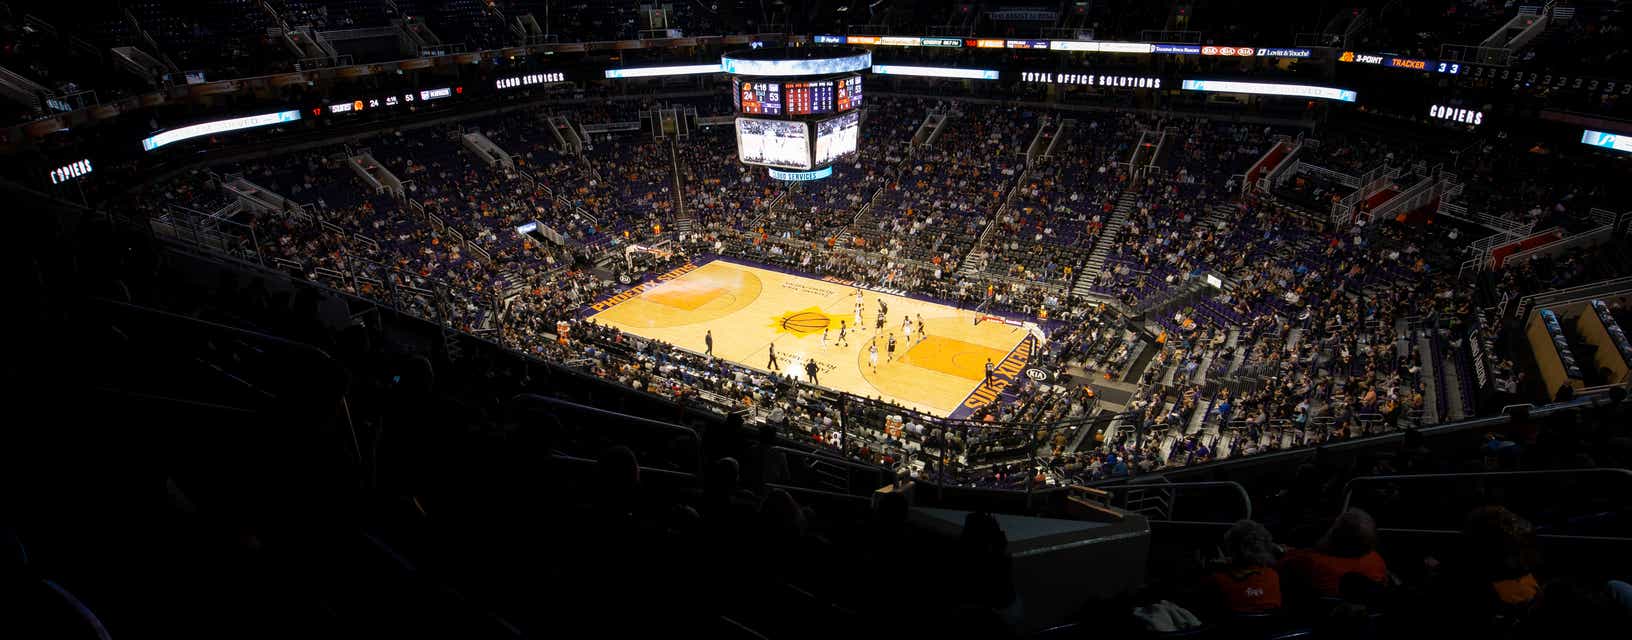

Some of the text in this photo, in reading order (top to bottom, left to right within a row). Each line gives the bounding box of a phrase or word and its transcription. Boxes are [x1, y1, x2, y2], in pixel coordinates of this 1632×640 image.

[1356, 54, 1384, 65] 3-POINT
[1392, 58, 1425, 70] TRACKER
[1438, 63, 1447, 73] 3
[1450, 64, 1459, 74] 3
[496, 72, 564, 89] CLOUD SERVICES
[1021, 72, 1161, 89] TOTAL OFFICE SOLUTIONS
[369, 100, 379, 108] 24
[404, 94, 414, 102] 53
[743, 91, 753, 101] 24
[769, 93, 779, 102] 53
[1429, 104, 1483, 125] COPIERS
[50, 158, 93, 185] COPIERS
[788, 172, 817, 181] SERVICES
[1029, 370, 1044, 381] KIA
[963, 376, 1012, 409] SUNS
